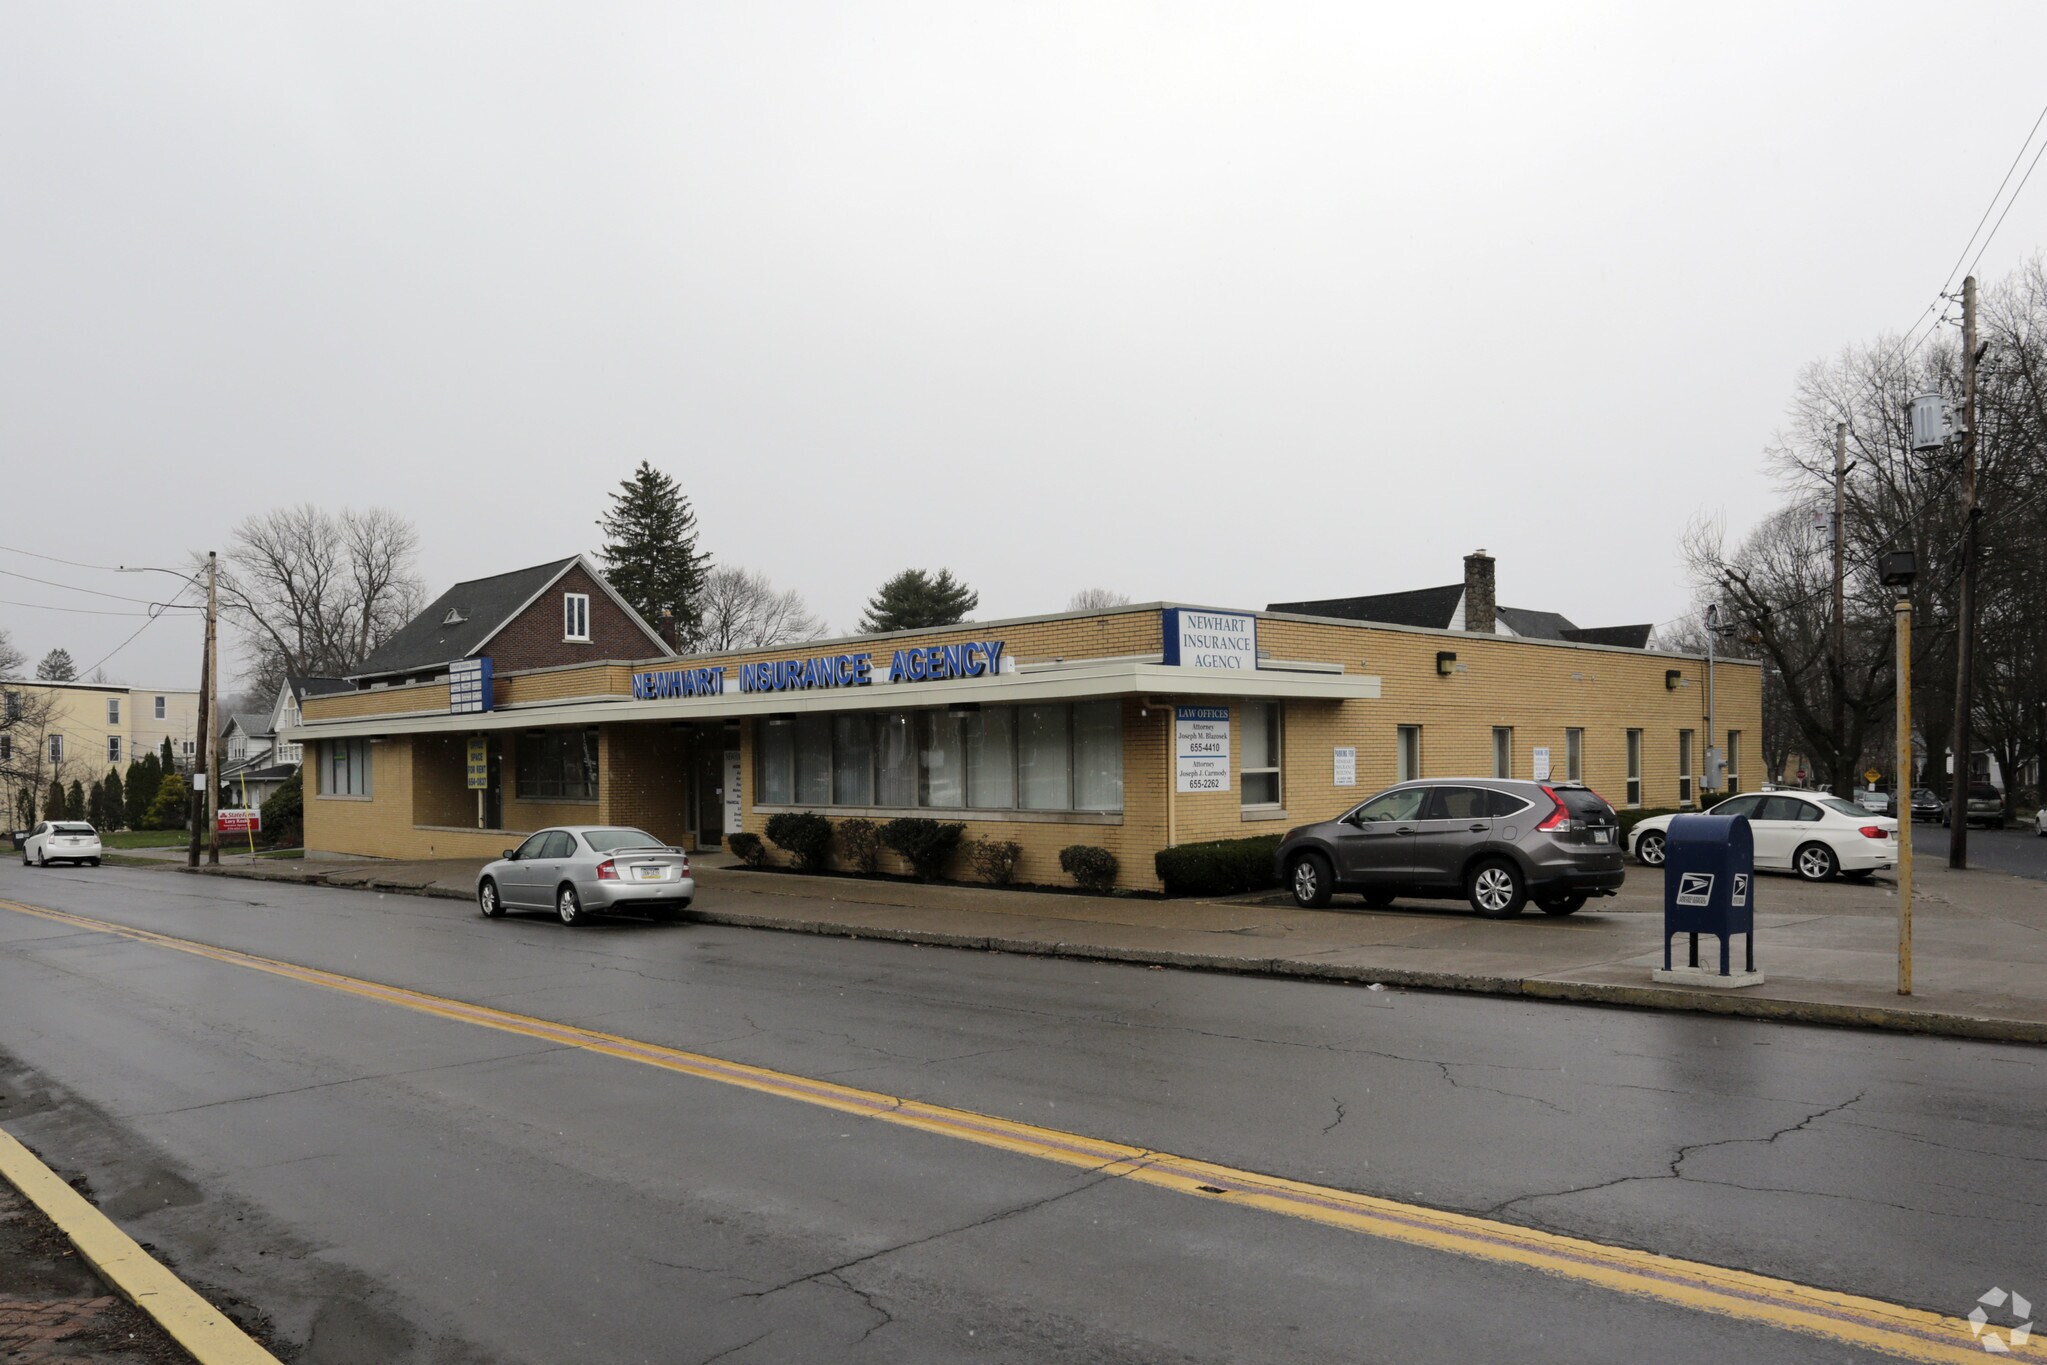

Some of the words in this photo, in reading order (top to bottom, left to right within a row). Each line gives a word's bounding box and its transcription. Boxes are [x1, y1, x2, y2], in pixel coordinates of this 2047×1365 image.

[1187, 615, 1246, 632] NEWHART
[1184, 634, 1251, 651] INSURANCE
[1195, 654, 1242, 669] AGENCY
[632, 666, 726, 699] NEWHART
[739, 653, 871, 692] INSURANCE
[889, 641, 1004, 682] AGENCY
[1179, 709, 1196, 718] LAW
[1197, 709, 1229, 718] OFFICES
[1192, 723, 1214, 731] Attorney
[1178, 732, 1197, 741] Joseph
[1198, 732, 1204, 740] M.
[1190, 743, 1220, 752] 655-4410
[1180, 770, 1198, 778] Joseph
[1204, 769, 1227, 778] Carmody
[1189, 779, 1220, 788] 655-2262
